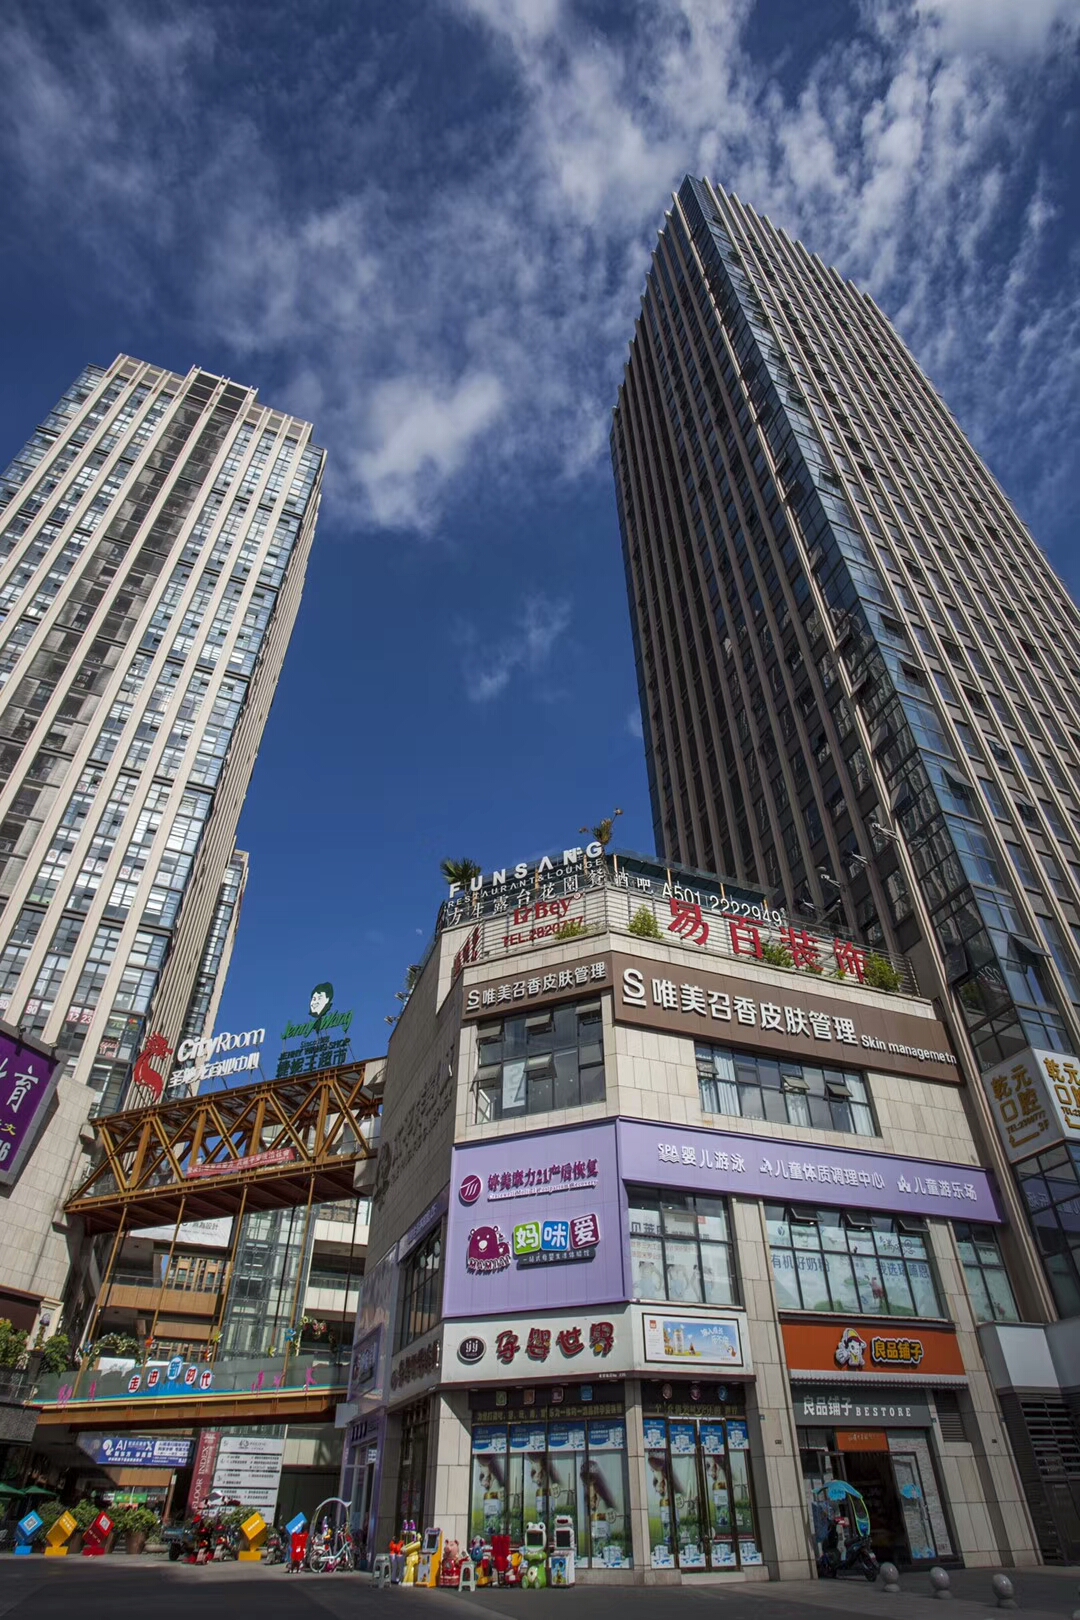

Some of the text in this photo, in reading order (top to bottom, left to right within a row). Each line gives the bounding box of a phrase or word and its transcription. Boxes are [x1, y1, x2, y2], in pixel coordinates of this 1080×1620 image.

[449, 841, 603, 898] FUNSANG
[667, 898, 868, 985] 易百装饰
[481, 961, 607, 1005] 唯美召香皮肤管理
[651, 978, 859, 1046] 唯美召香皮肤管理
[861, 1034, 887, 1051] Skin
[177, 1027, 266, 1063] CityRoom
[658, 1142, 747, 1174] SPA 婴儿游泳
[774, 1159, 886, 1190] 儿童体质调理中心
[913, 1175, 977, 1202] 儿童游乐场
[515, 1214, 597, 1250] 妈咪爱
[496, 1321, 615, 1363] 孕婴世界
[872, 1337, 925, 1365] 良品铺子
[128, 1357, 213, 1392] 走进新时代
[803, 1394, 912, 1418] 良品铺子 BESTORE
[197, 1445, 210, 1475] INDEX
